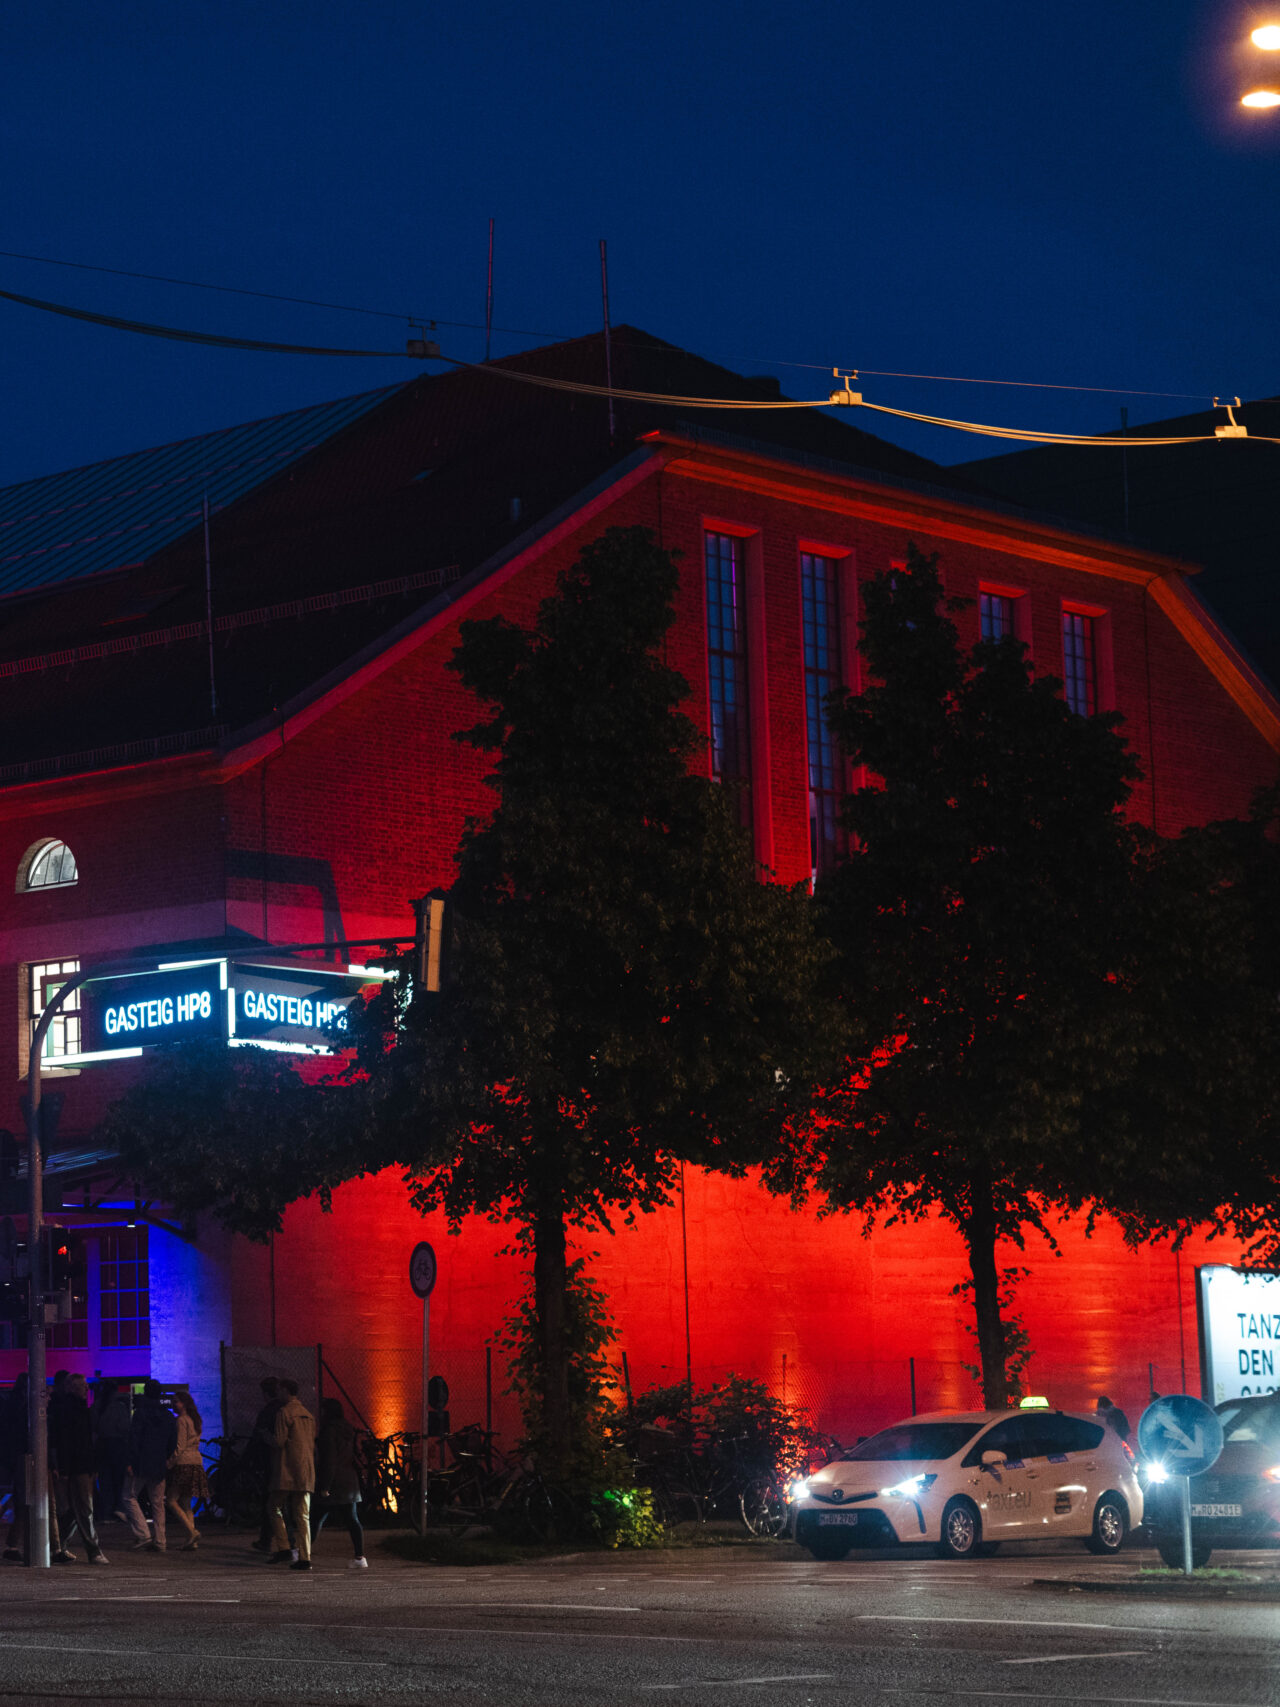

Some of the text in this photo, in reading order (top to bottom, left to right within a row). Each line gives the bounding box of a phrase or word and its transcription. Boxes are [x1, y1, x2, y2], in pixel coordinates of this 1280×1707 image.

[106, 991, 211, 1034] GASTEIG HP8
[244, 990, 313, 1026] GASTEIG
[1238, 1349, 1274, 1376] DEN
